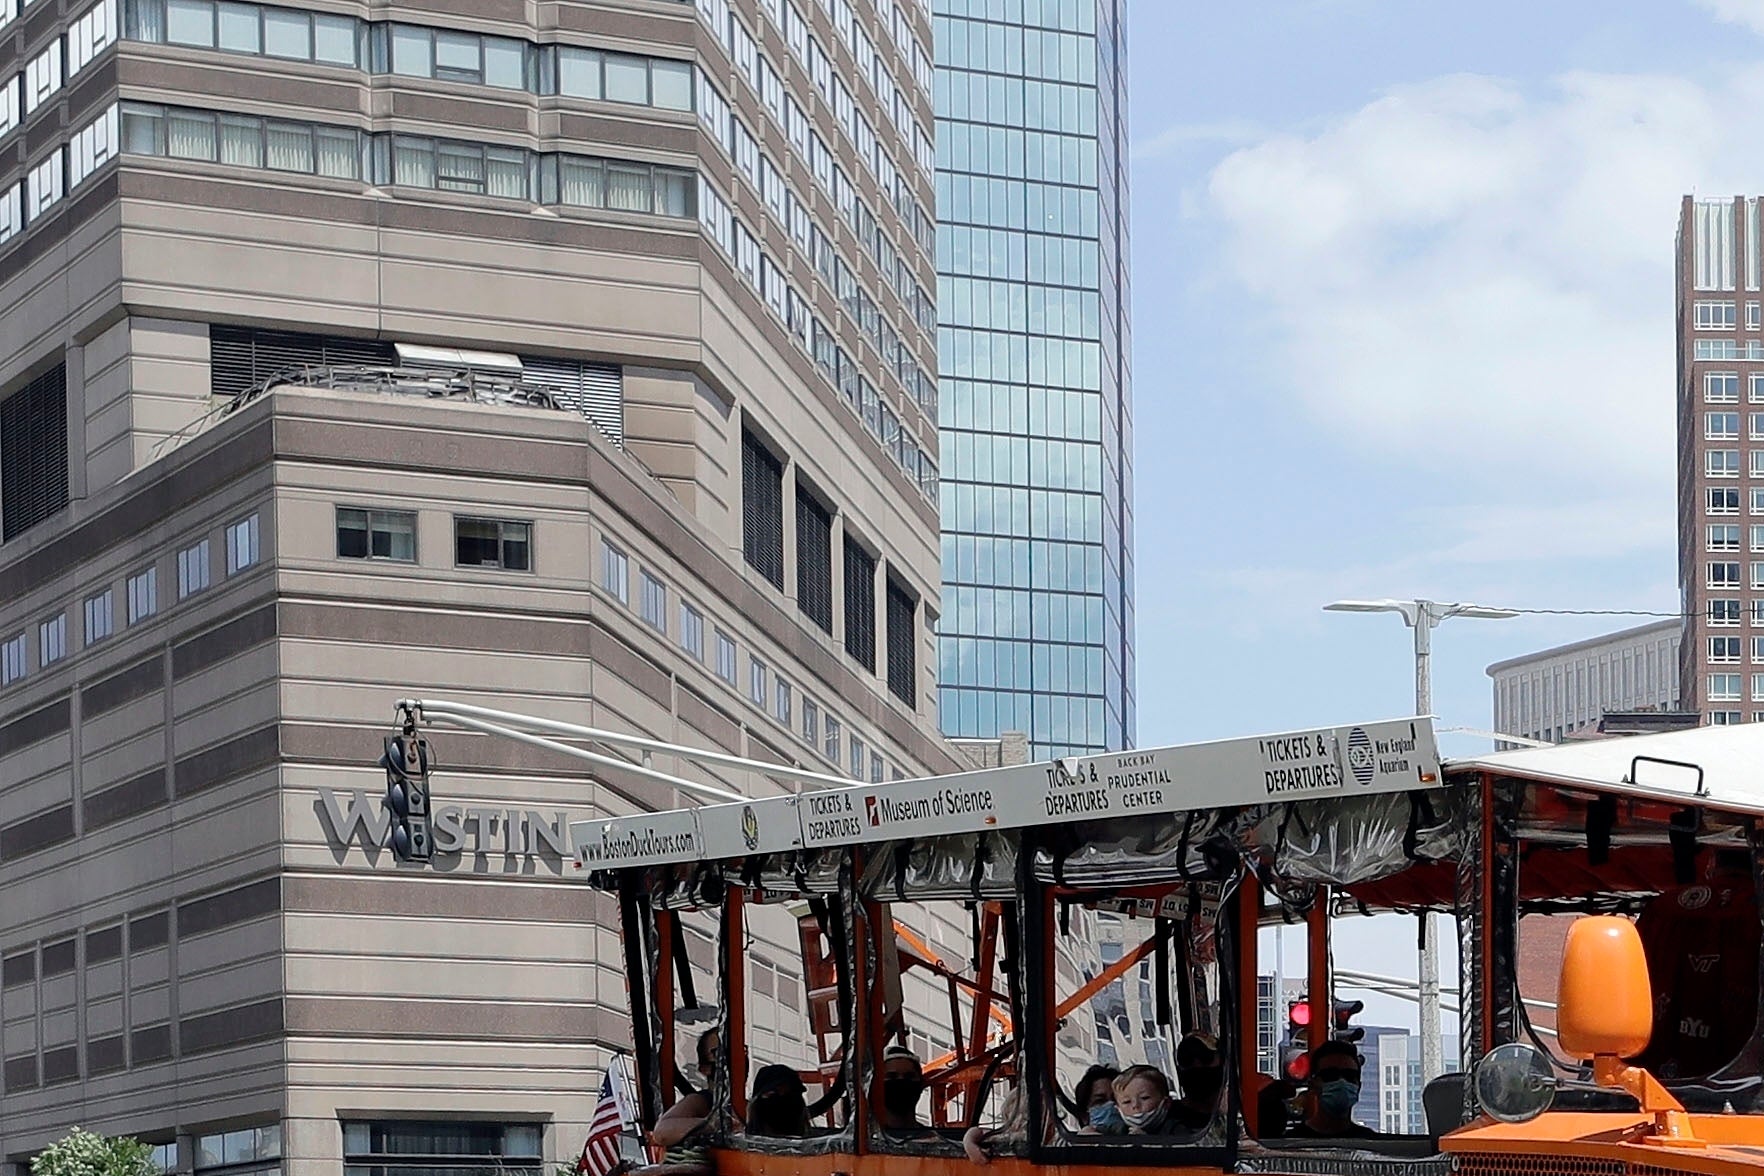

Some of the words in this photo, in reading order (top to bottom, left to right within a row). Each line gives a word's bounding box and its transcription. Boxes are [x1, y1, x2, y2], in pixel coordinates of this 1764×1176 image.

[1267, 736, 1311, 763] TICKETS
[1316, 734, 1327, 756] &
[1375, 740, 1389, 754] New
[1090, 762, 1099, 782] &
[1118, 757, 1138, 768] BACK
[1140, 754, 1155, 766] BAY
[1379, 759, 1409, 775] Aquarium
[1108, 769, 1172, 789] PRUDENTIAL
[1265, 764, 1339, 795] DEPARTURES
[810, 794, 843, 816] TICKETS
[845, 793, 853, 811] &
[880, 798, 931, 823] Museum
[933, 790, 942, 816] of
[945, 788, 992, 815] Science
[1045, 789, 1109, 816] DEPARTURES
[1123, 790, 1163, 808] CENTER
[317, 786, 574, 856] WSTIN
[808, 817, 861, 841] DEPARTURES
[580, 828, 694, 862] www.BostonDuckTours.com
[1679, 1017, 1711, 1039] BYU
